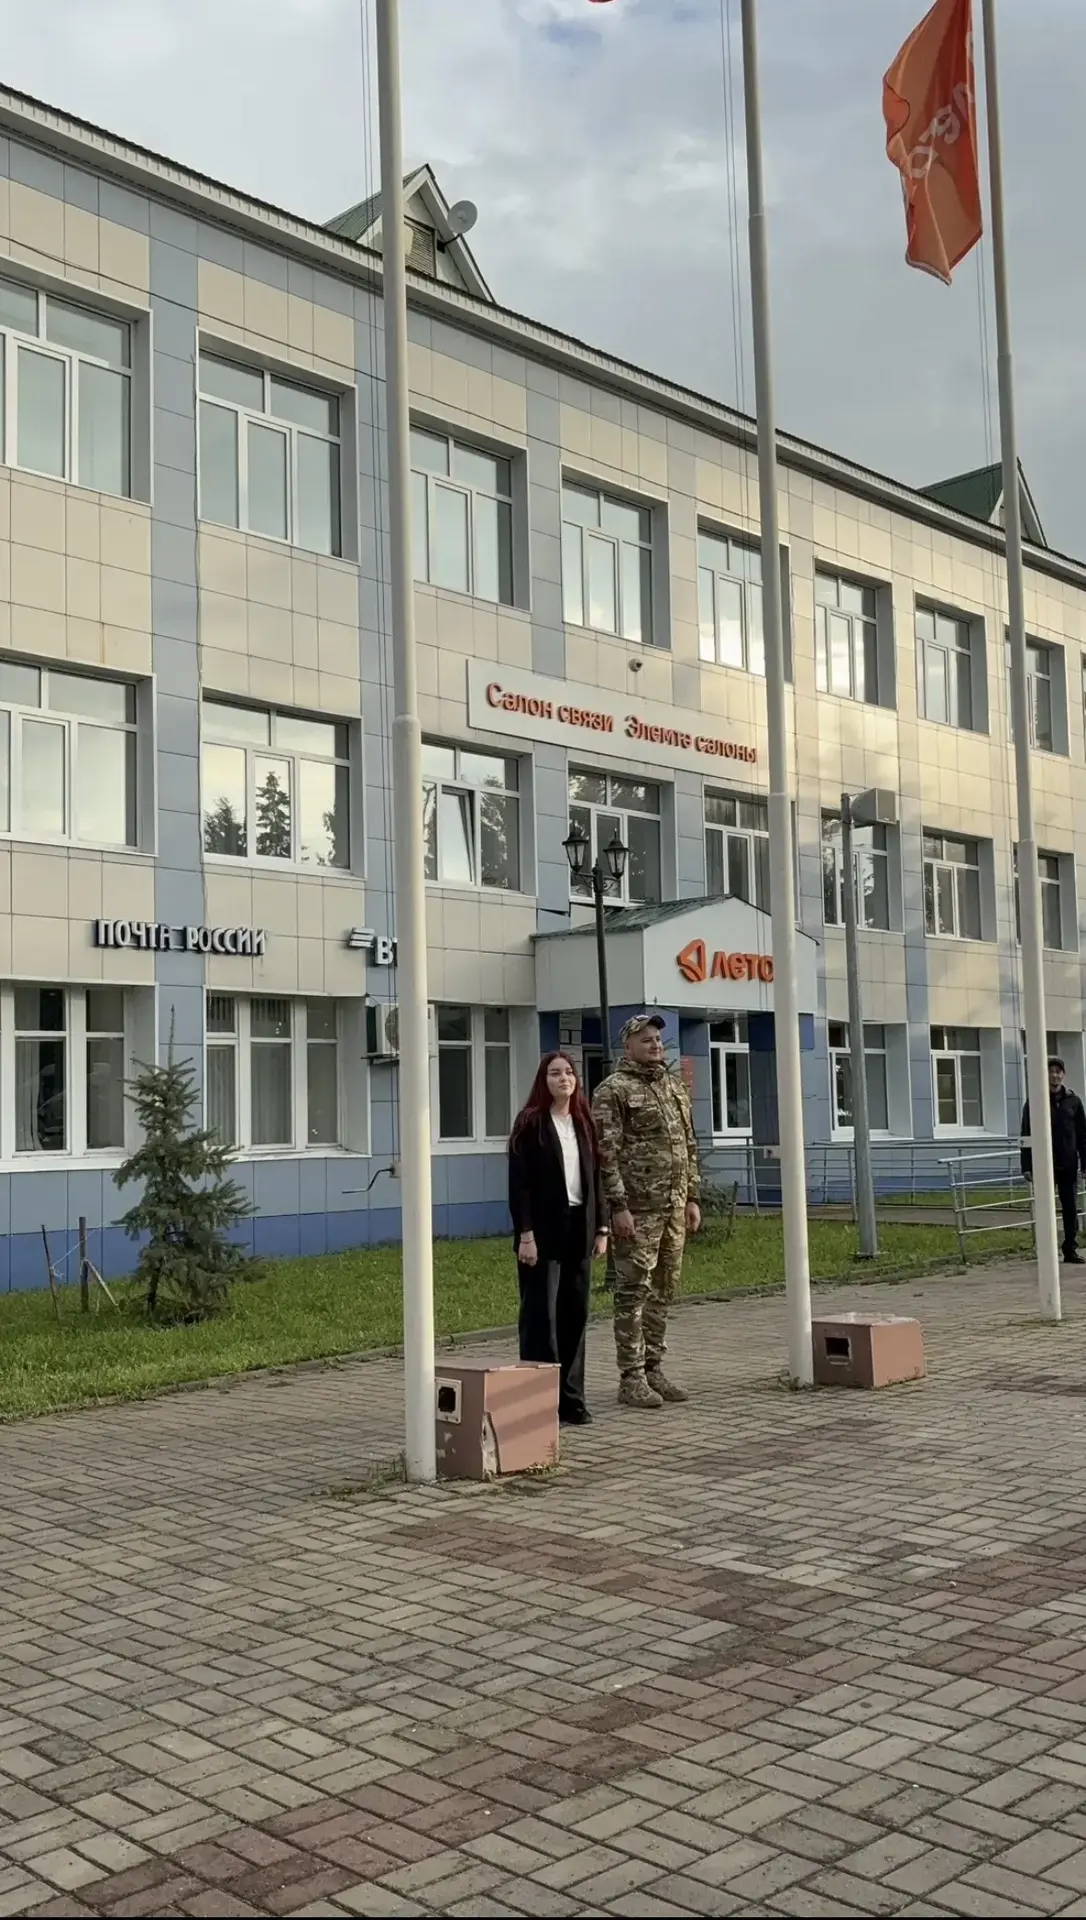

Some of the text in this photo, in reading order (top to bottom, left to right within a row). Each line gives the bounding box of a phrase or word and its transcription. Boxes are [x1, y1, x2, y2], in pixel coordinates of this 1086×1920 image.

[486, 682, 553, 719] Салон
[557, 705, 615, 733] связи
[695, 735, 758, 764] салоны
[96, 918, 266, 956] ПОЧТА РОССИИ
